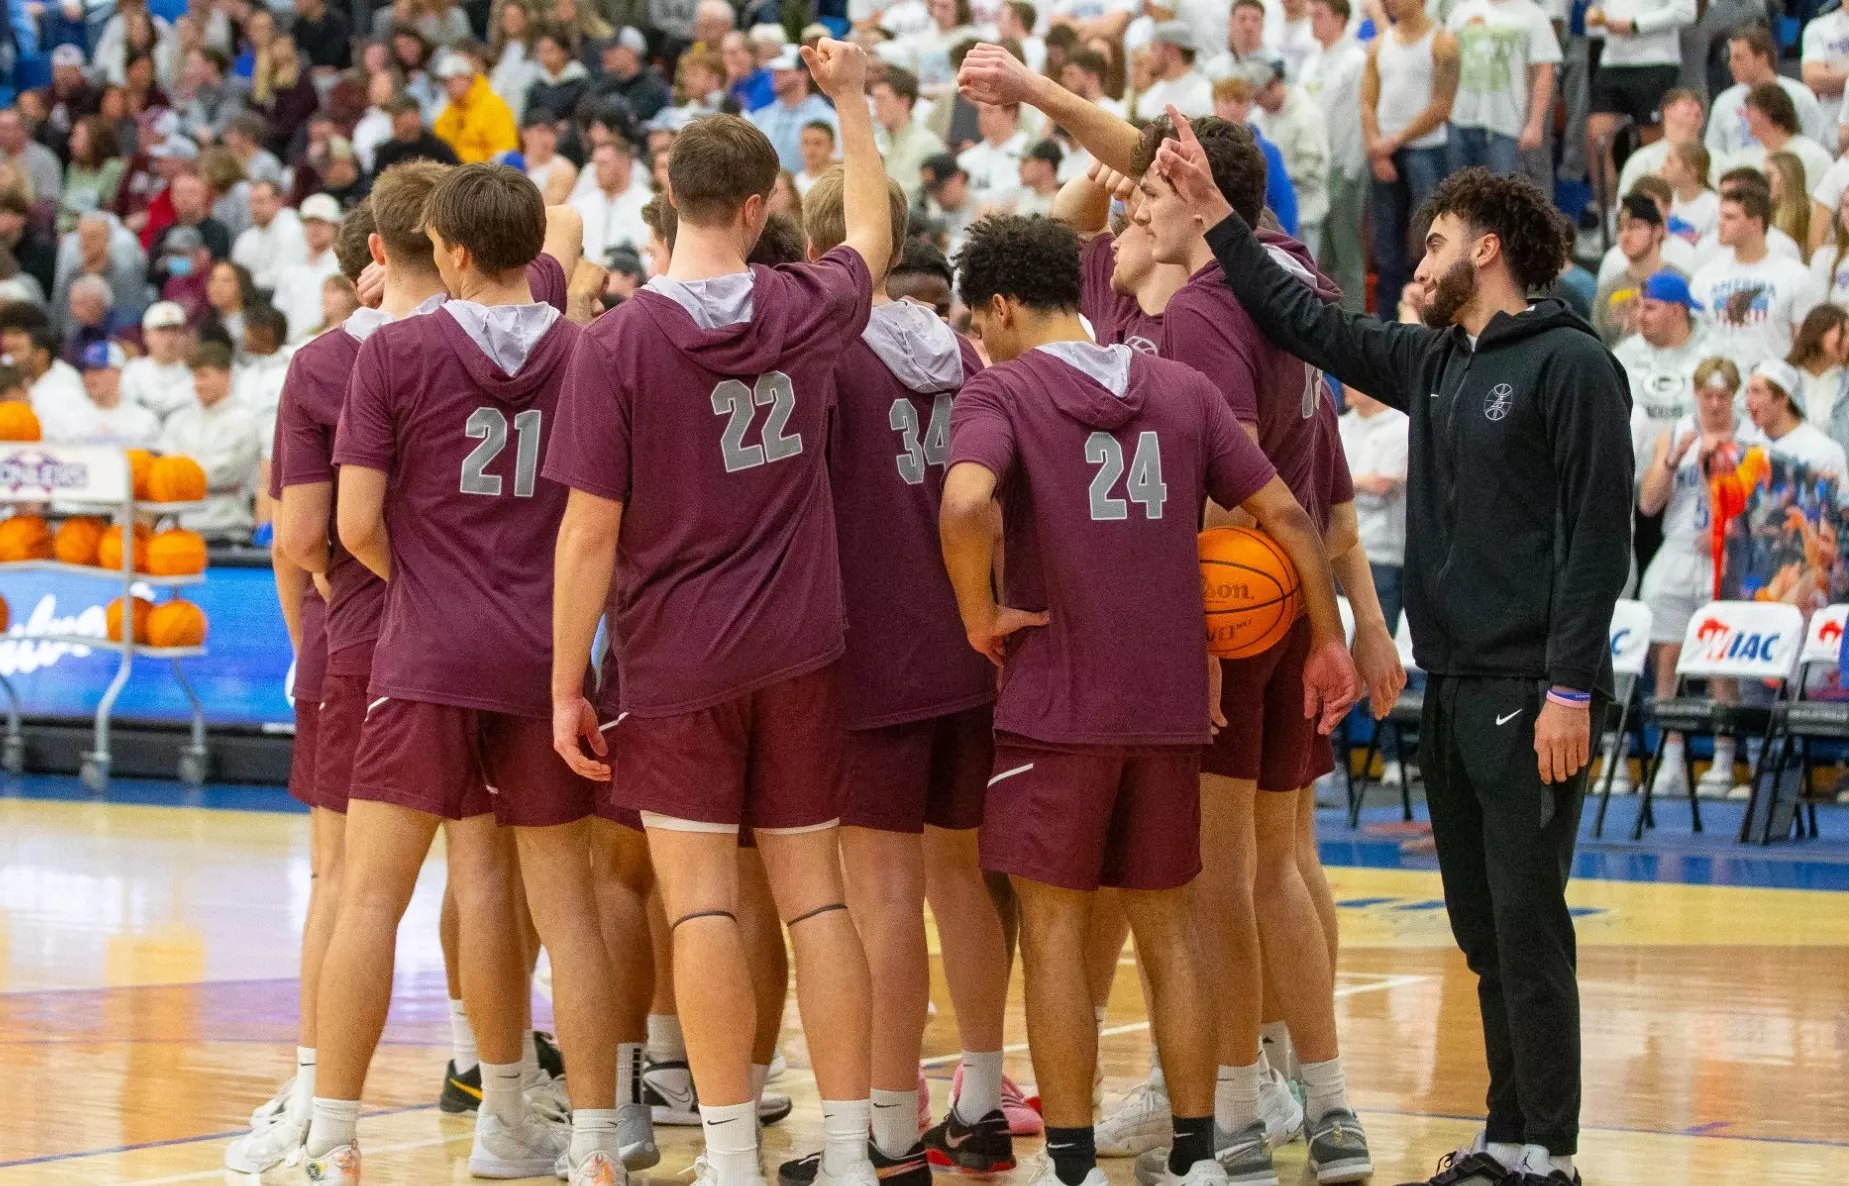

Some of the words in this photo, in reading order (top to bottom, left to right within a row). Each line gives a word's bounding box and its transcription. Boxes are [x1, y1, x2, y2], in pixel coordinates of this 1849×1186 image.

[460, 406, 542, 497] 21
[711, 370, 803, 473] 22
[889, 393, 953, 485] 34
[1085, 431, 1167, 520] 24
[1697, 616, 1781, 662] WIAC
